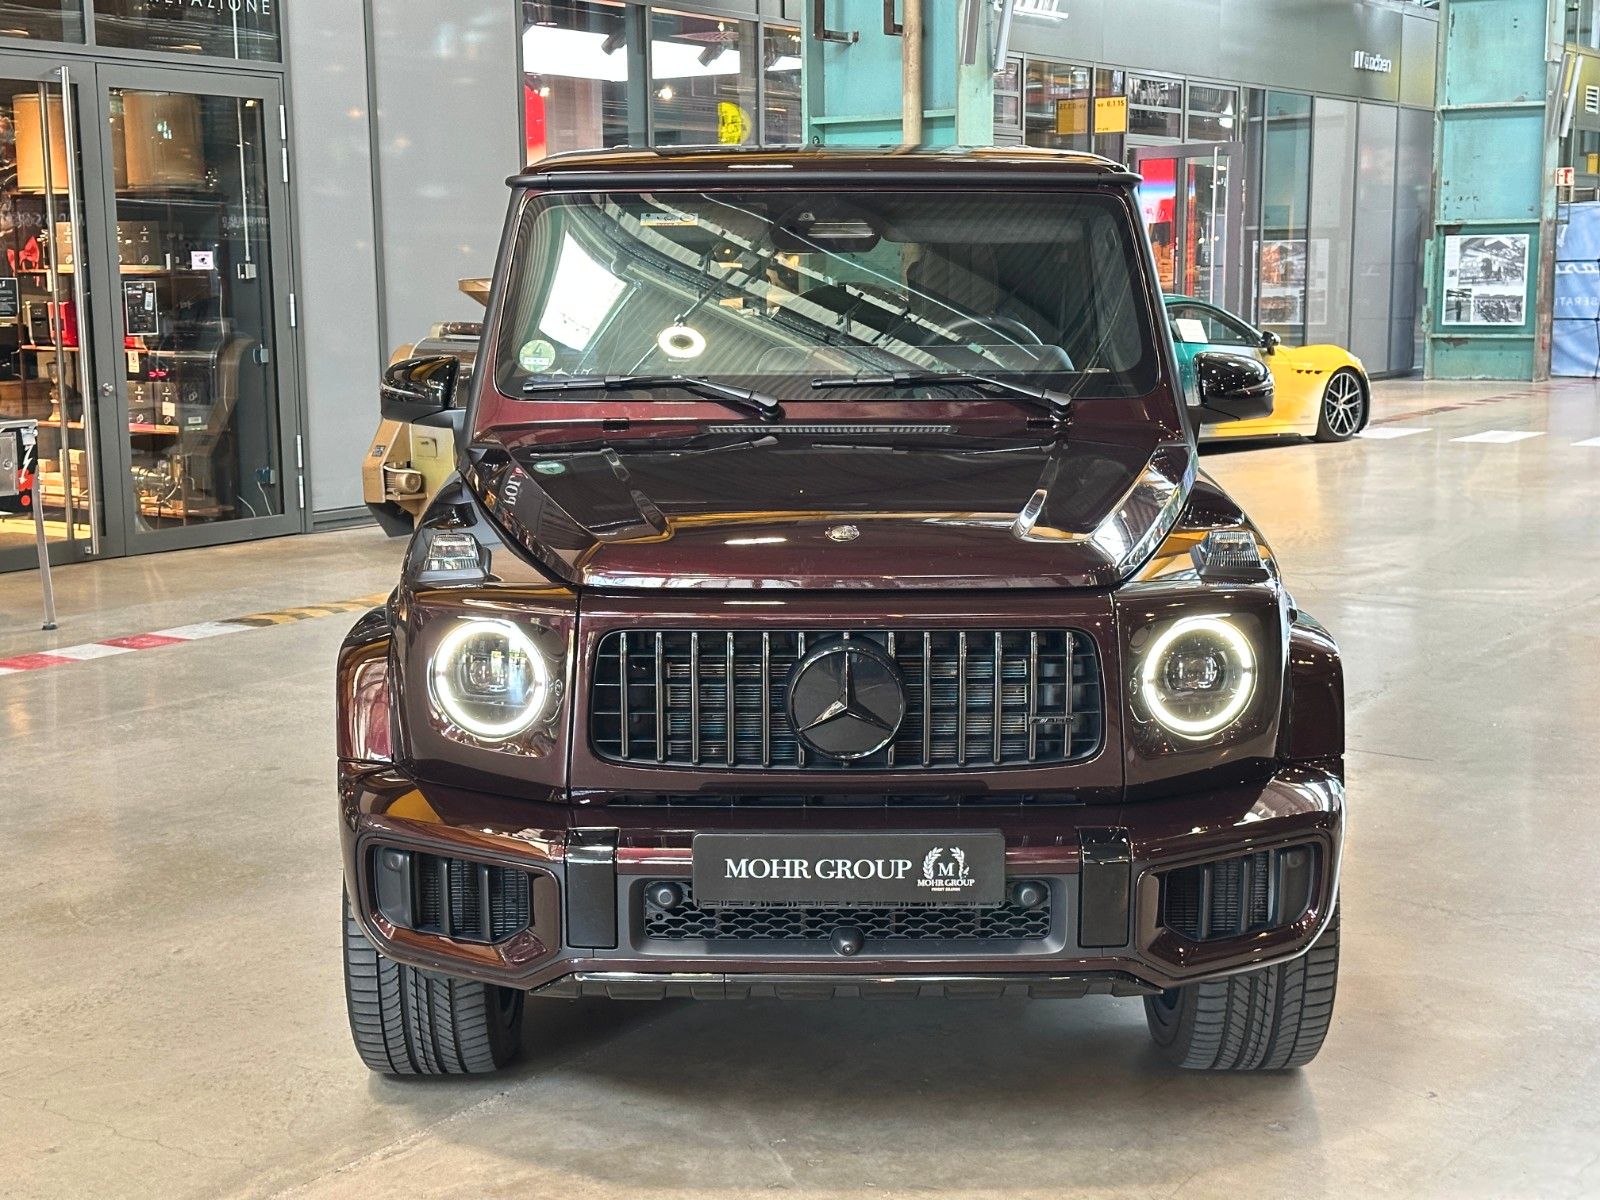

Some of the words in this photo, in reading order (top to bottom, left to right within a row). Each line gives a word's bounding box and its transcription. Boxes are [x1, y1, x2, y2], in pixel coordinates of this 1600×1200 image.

[724, 858, 811, 879] MOHR
[814, 858, 912, 879] GROUP
[937, 862, 955, 877] M
[917, 879, 944, 887] MOHR
[944, 879, 976, 887] GROUP
